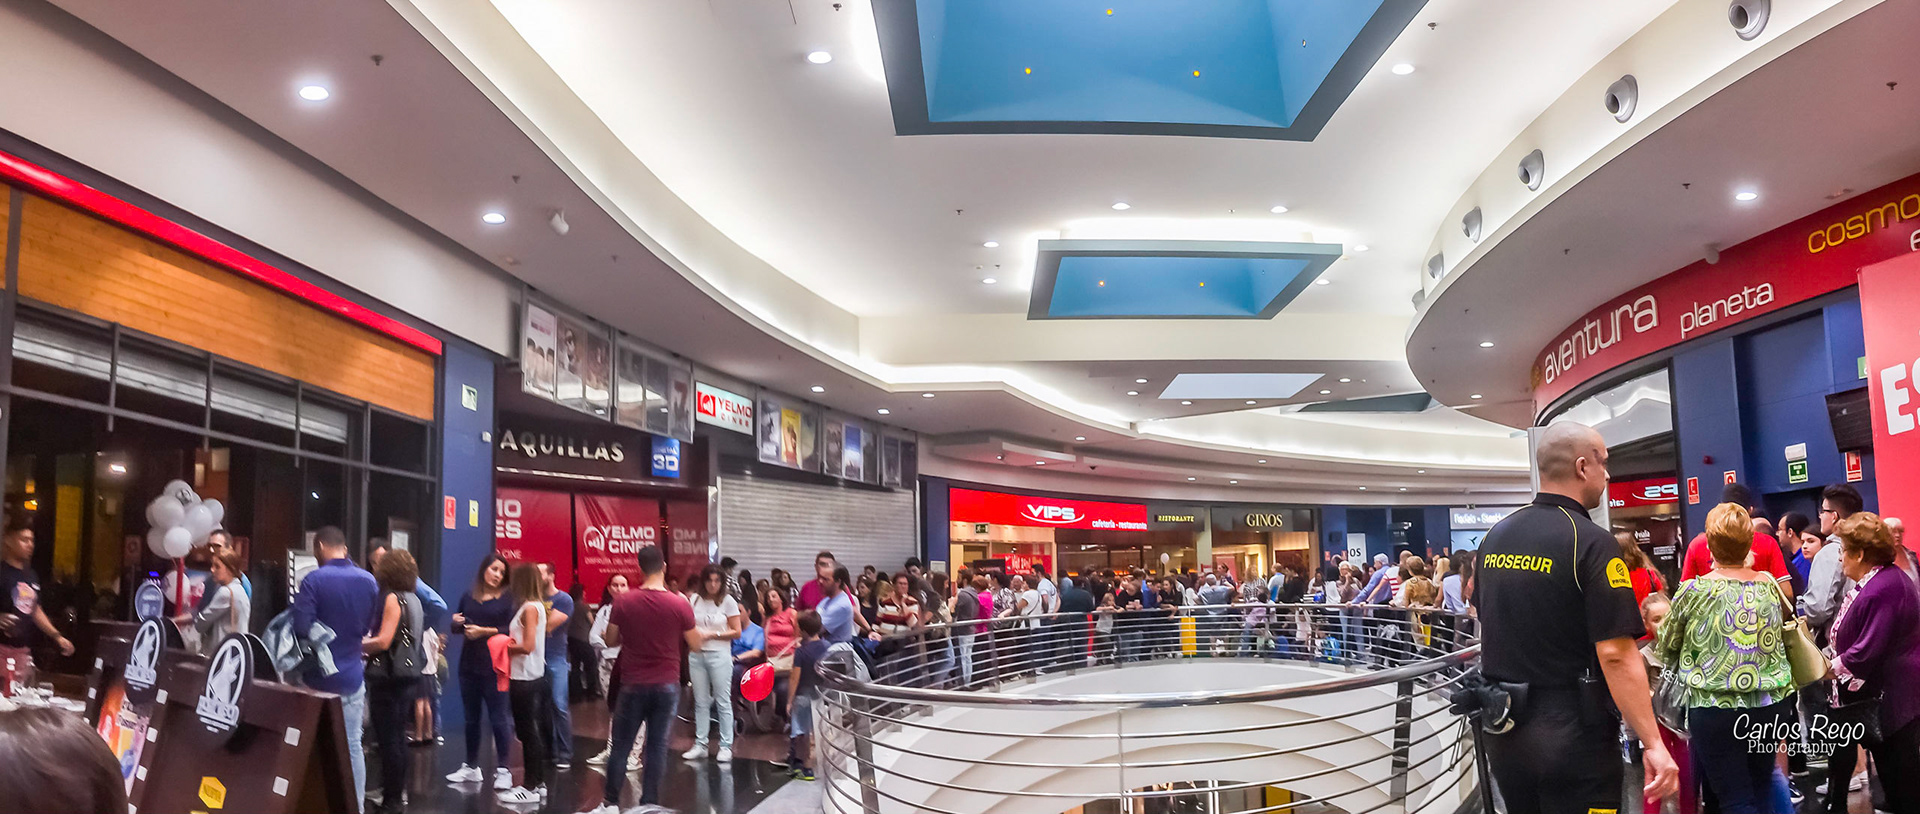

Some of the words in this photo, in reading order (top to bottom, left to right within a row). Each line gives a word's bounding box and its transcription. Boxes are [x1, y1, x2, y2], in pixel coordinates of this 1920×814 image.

[1808, 193, 1920, 254] cosmo
[1680, 282, 1774, 339] planeta
[1545, 294, 1660, 384] aventura
[718, 397, 753, 419] YELMO
[720, 413, 750, 428] CINES
[652, 453, 679, 472] 3D
[1027, 504, 1075, 520] VIPS
[1158, 515, 1194, 523] RISTORANTE
[1246, 513, 1283, 527] GINOS
[602, 525, 655, 540] YELMO
[1119, 521, 1147, 530] restaurante
[1484, 553, 1553, 574] PROSEGUR
